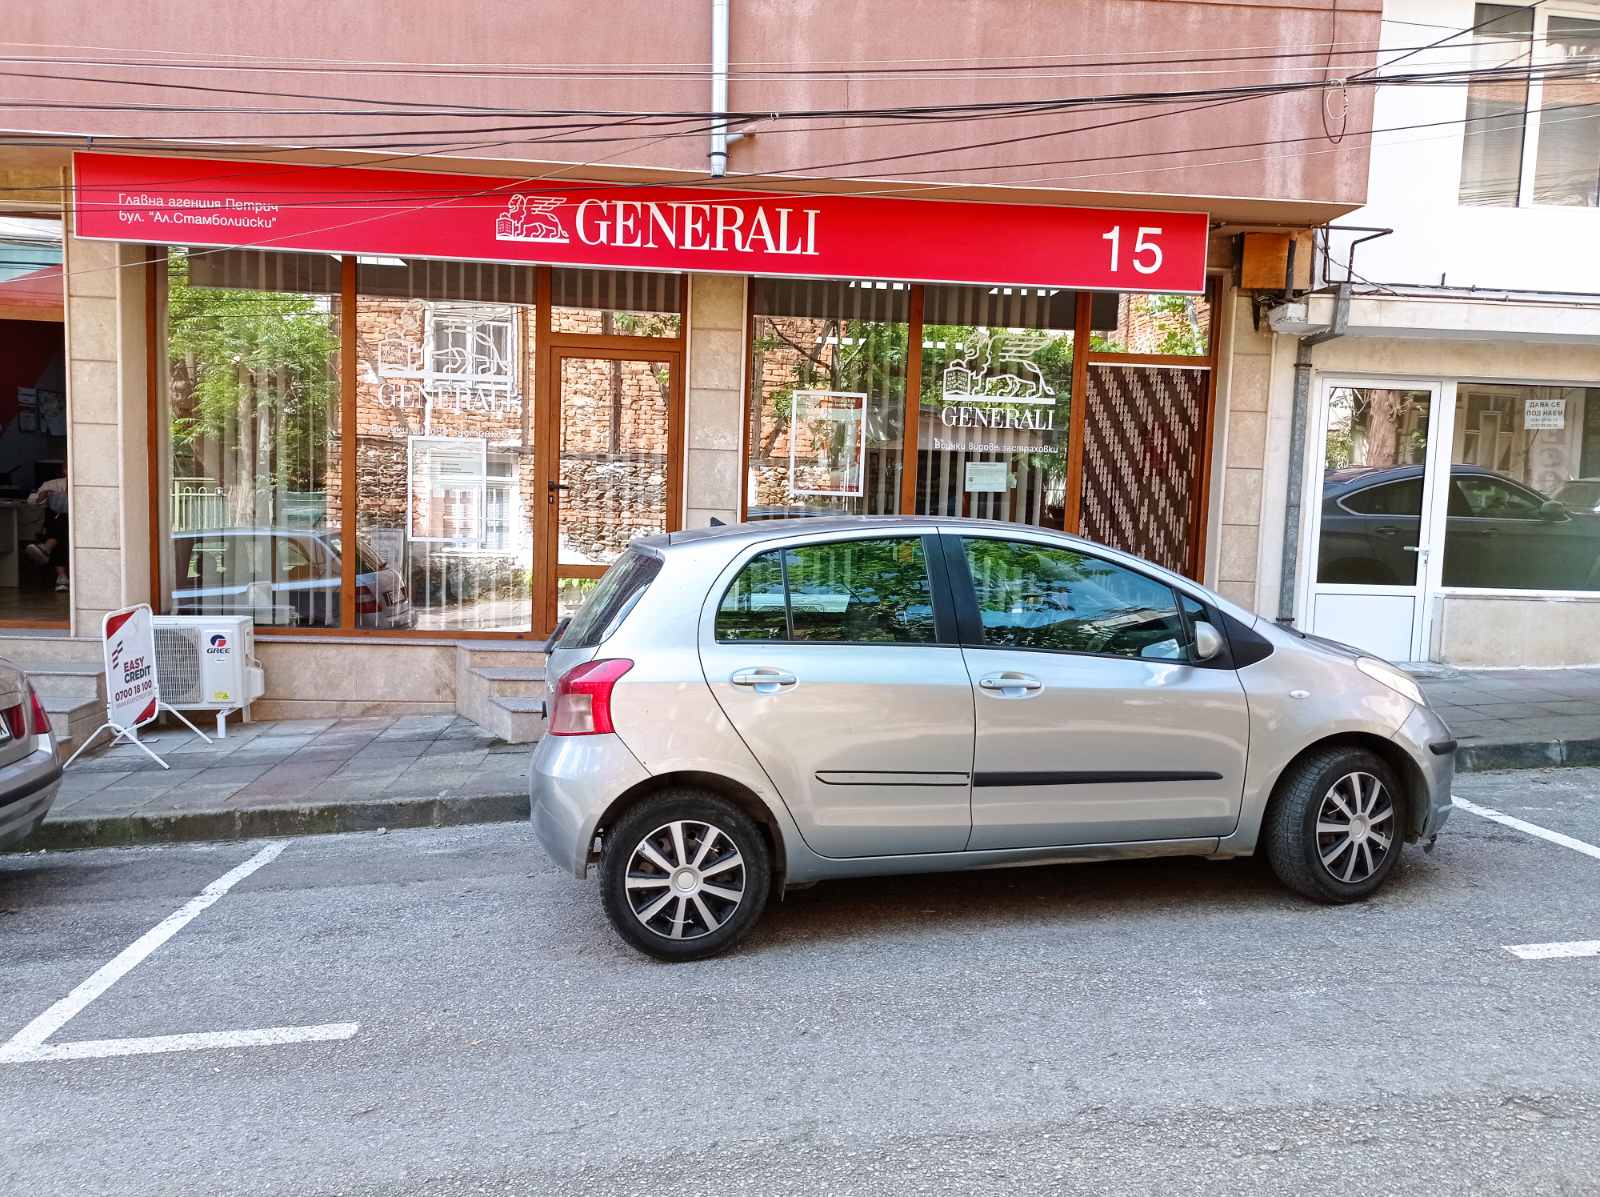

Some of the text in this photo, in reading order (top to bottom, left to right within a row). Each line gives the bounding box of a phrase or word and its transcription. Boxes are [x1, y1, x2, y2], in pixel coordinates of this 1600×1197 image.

[118, 193, 279, 214] Главна агенция Петрич
[119, 210, 145, 224] бул.
[575, 198, 821, 256] GENERALI
[1102, 225, 1163, 274] 15
[377, 383, 512, 412] GENERALI
[941, 404, 1056, 431] GENERALI
[123, 656, 145, 673] EASY
[124, 665, 151, 684] CREDIT
[115, 687, 133, 702] 0700
[133, 685, 141, 695] 18
[142, 679, 152, 692] 100
